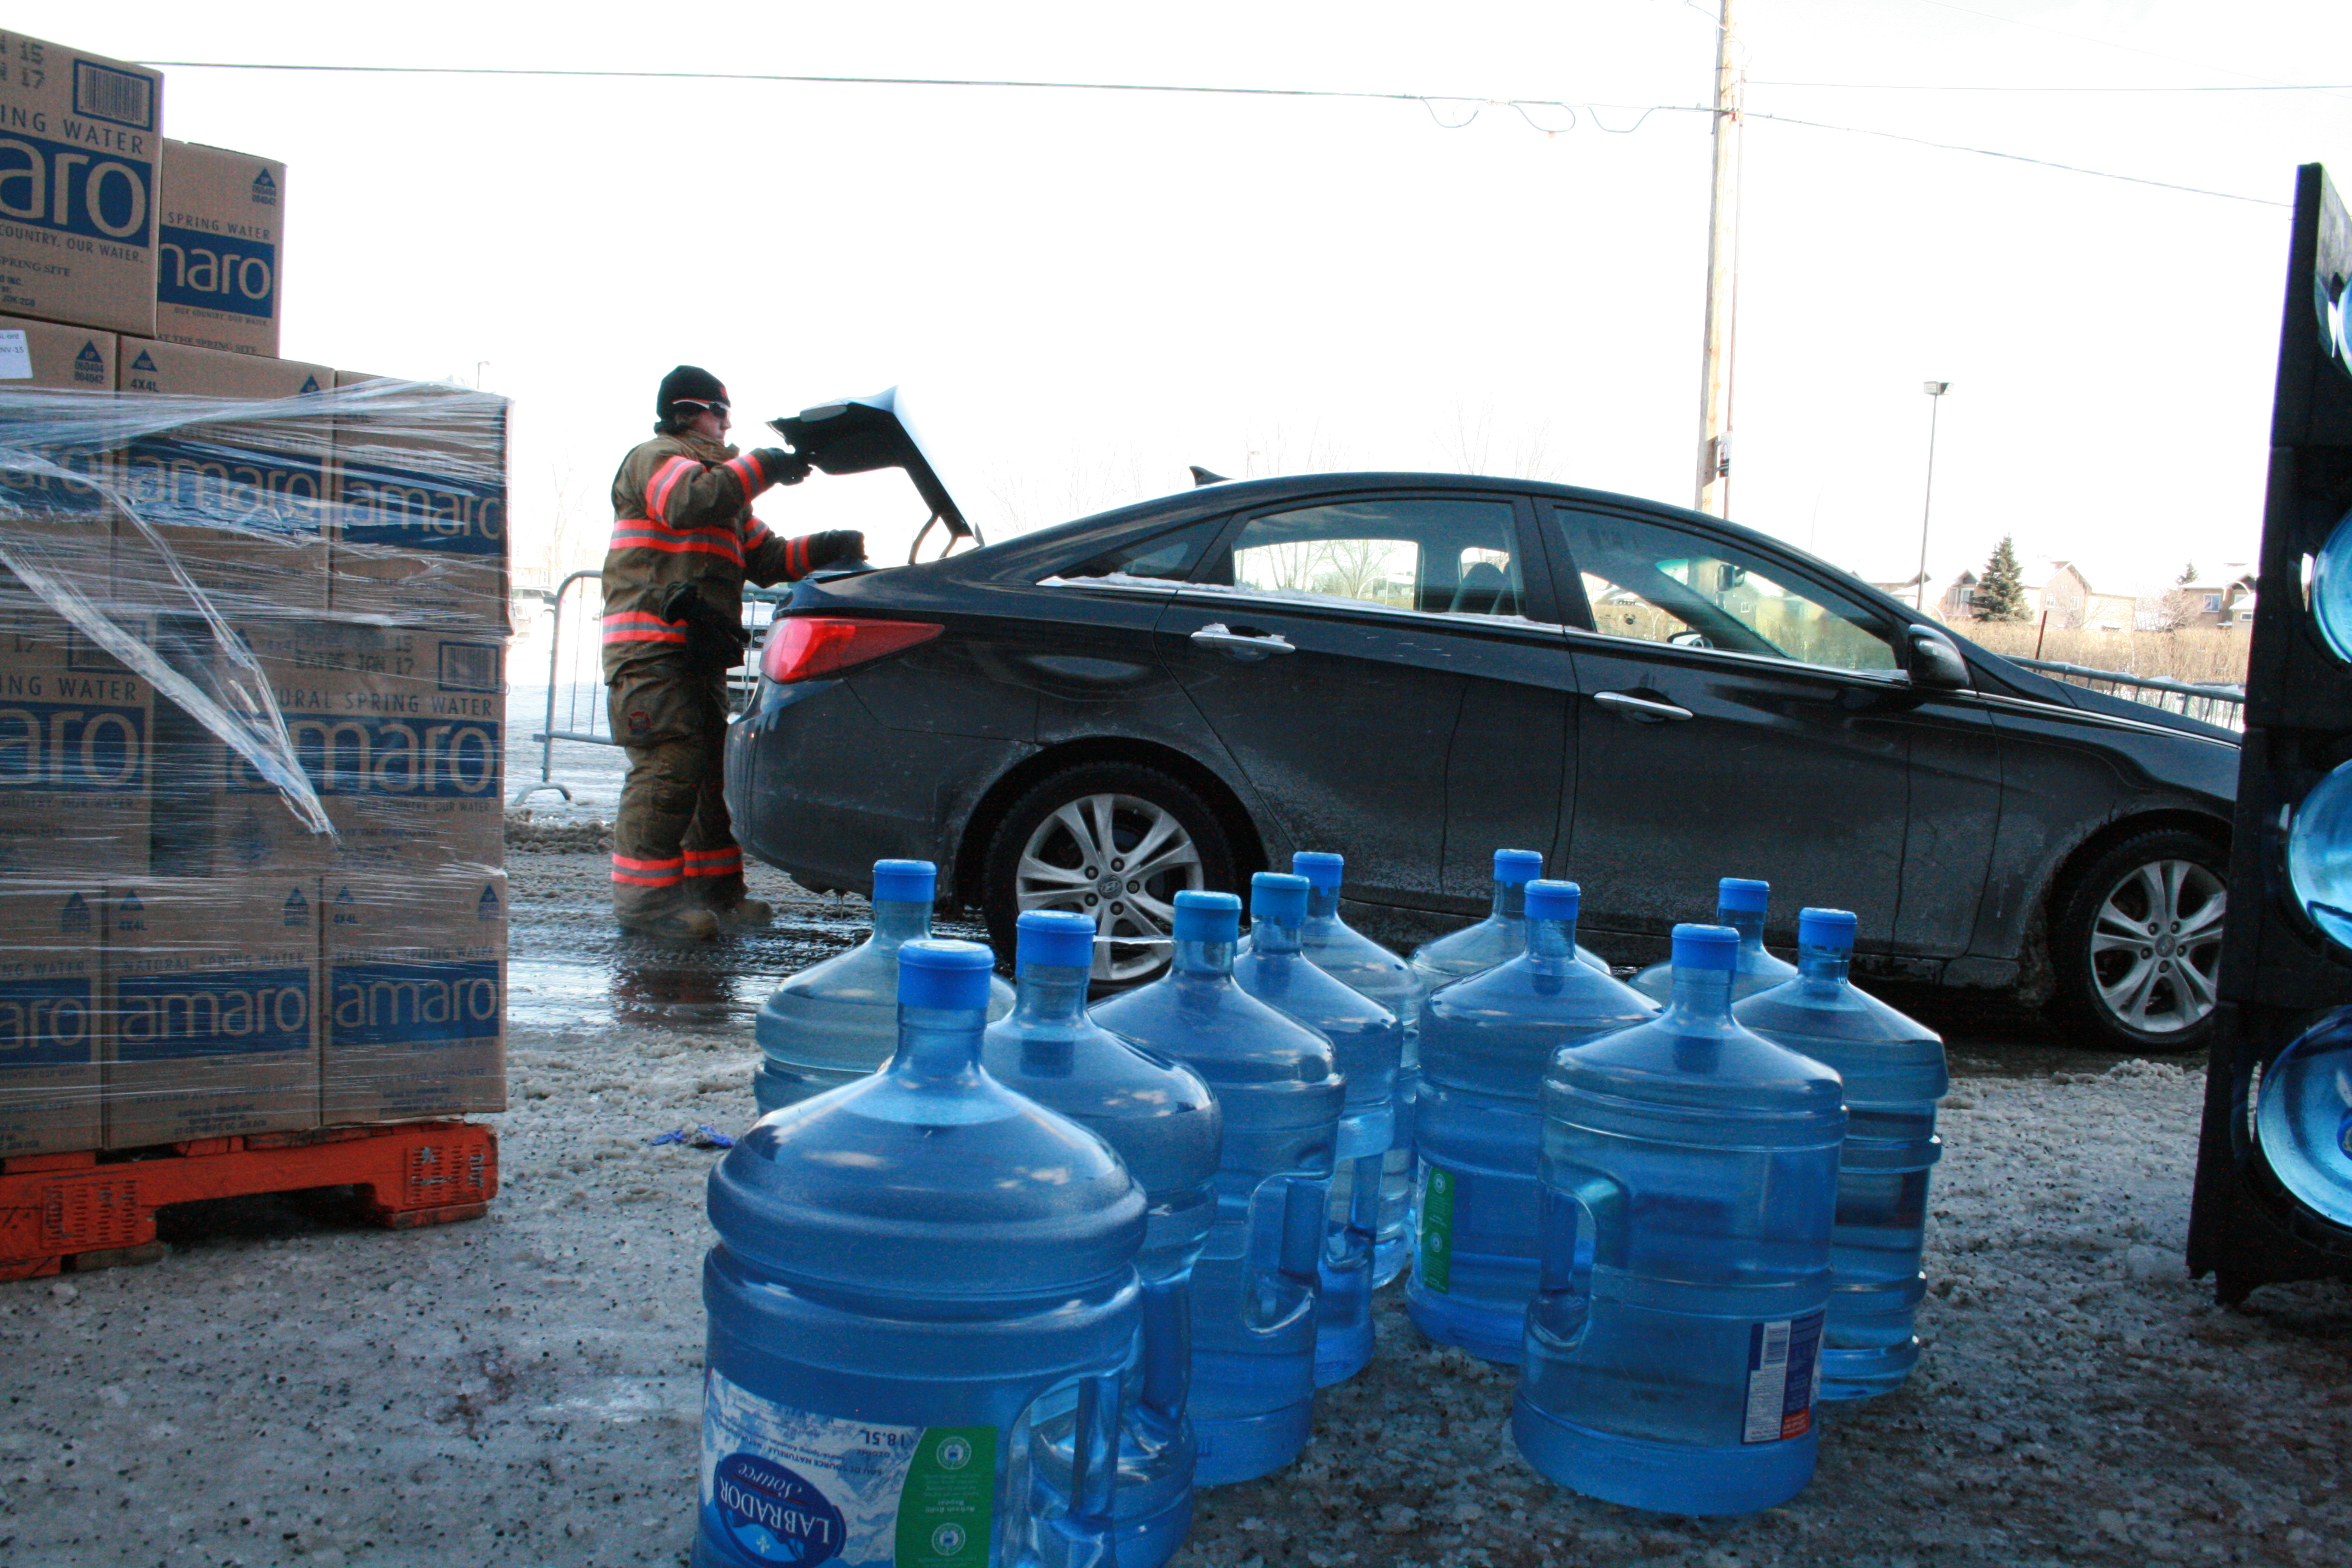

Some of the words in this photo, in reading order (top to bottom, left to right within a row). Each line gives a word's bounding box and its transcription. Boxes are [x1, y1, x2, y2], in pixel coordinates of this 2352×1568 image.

[22, 67, 45, 89] 17
[64, 119, 143, 154] WATER
[168, 211, 220, 231] SPRING
[226, 221, 270, 240] WATER
[67, 238, 93, 253] OUR
[99, 243, 144, 263] WATER.
[44, 263, 71, 276] SITE
[57, 677, 137, 701] WATER
[344, 691, 420, 713] SPRING
[431, 695, 492, 717] WATER
[122, 987, 307, 1042] amaro
[336, 978, 497, 1028] amaro
[859, 1429, 907, 1448] 18.5L
[813, 1458, 847, 1472] SOURCE
[849, 1465, 861, 1474] DE
[719, 1475, 831, 1544] LABRADOR
